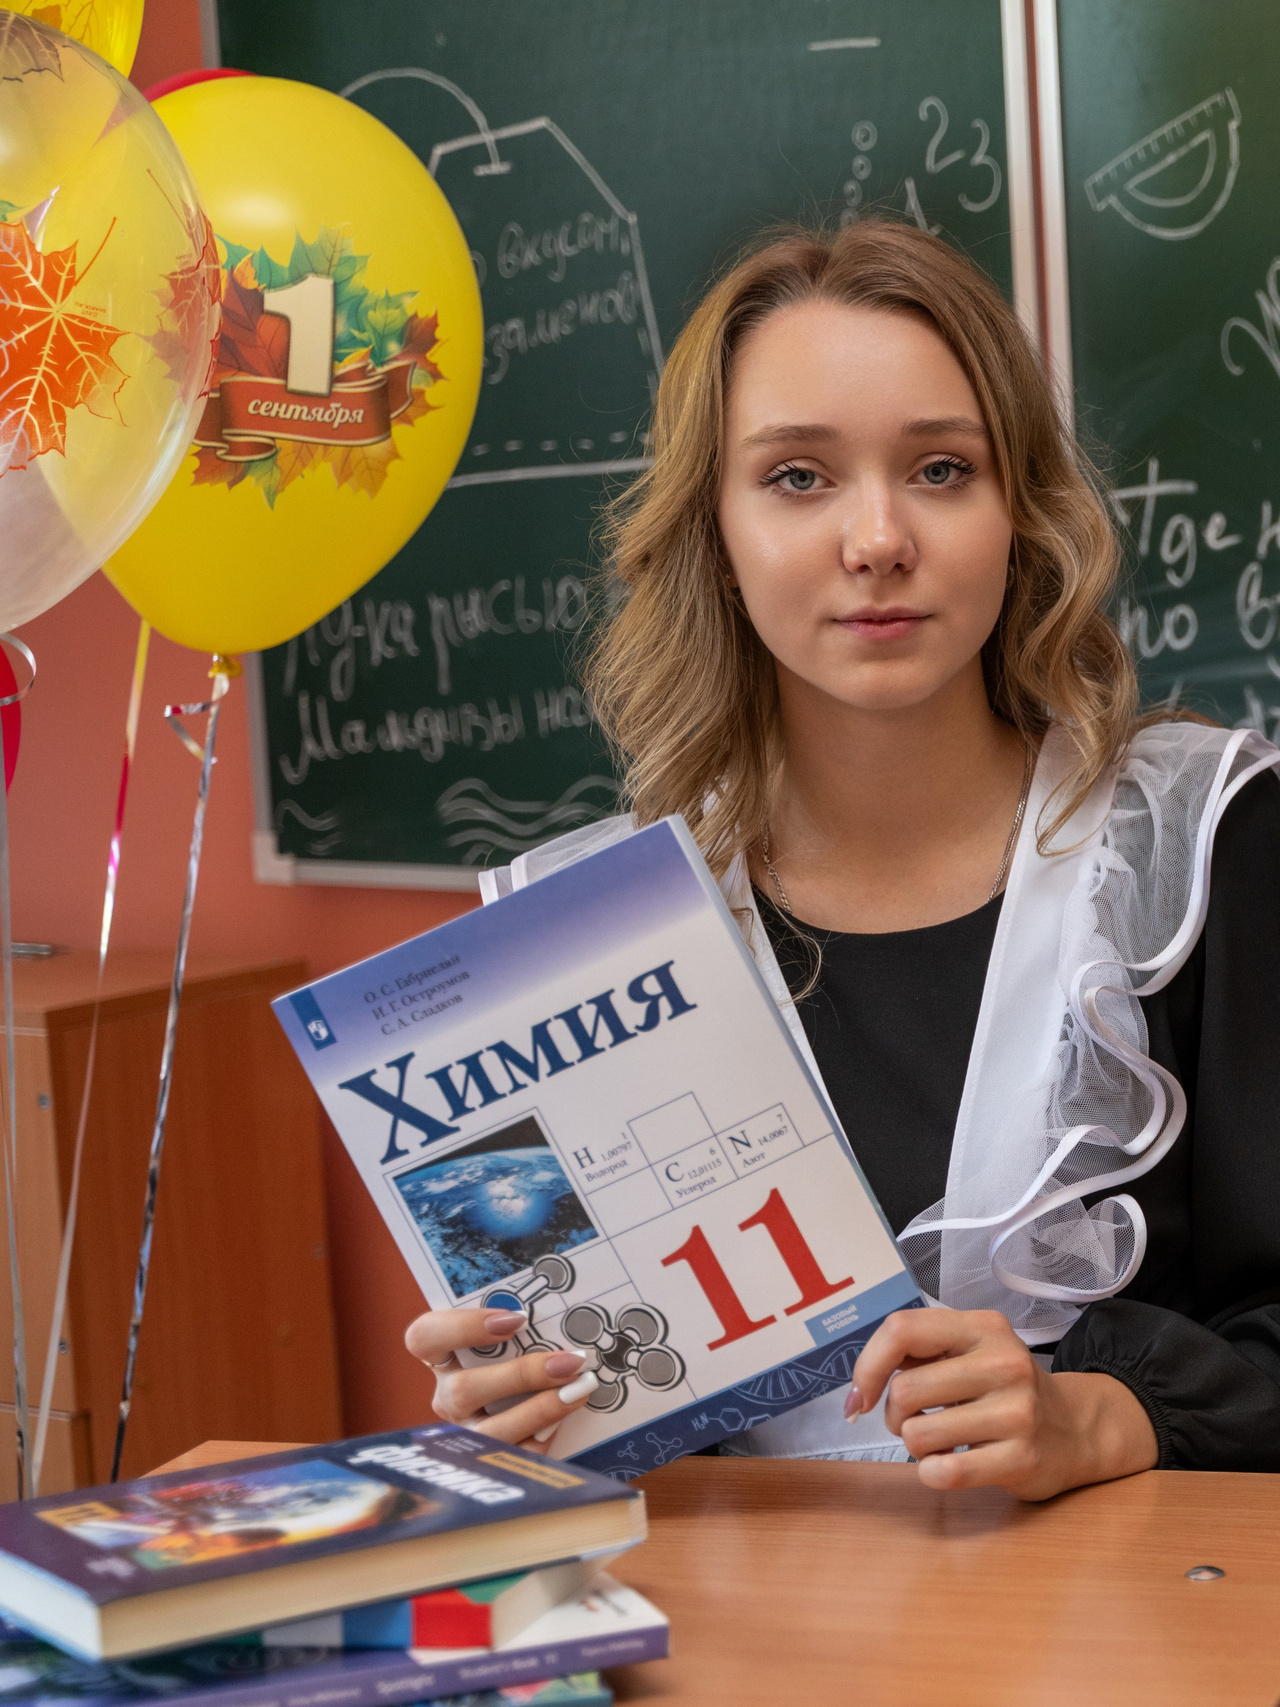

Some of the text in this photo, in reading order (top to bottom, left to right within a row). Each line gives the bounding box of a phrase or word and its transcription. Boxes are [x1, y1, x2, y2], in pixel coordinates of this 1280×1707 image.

[264, 273, 335, 396] 1
[483, 271, 639, 384] заменов
[248, 398, 365, 430] сентября
[364, 955, 461, 1004] О. С. Габриелян
[372, 971, 470, 1020] И. Г. Остроумов
[381, 994, 463, 1036] С. А. Сладков
[338, 960, 699, 1166] Химия
[572, 1141, 633, 1170] H 1,00797
[726, 1125, 789, 1156] N 14,0067
[584, 1158, 628, 1183] Водород
[687, 1158, 722, 1180] 12,01115
[742, 1151, 767, 1168] Азот
[675, 1175, 717, 1199] Углерод
[660, 1187, 855, 1352] 11
[822, 1304, 857, 1326] БАЗОВЫЙ
[826, 1314, 859, 1334] УРОВЕНЬ
